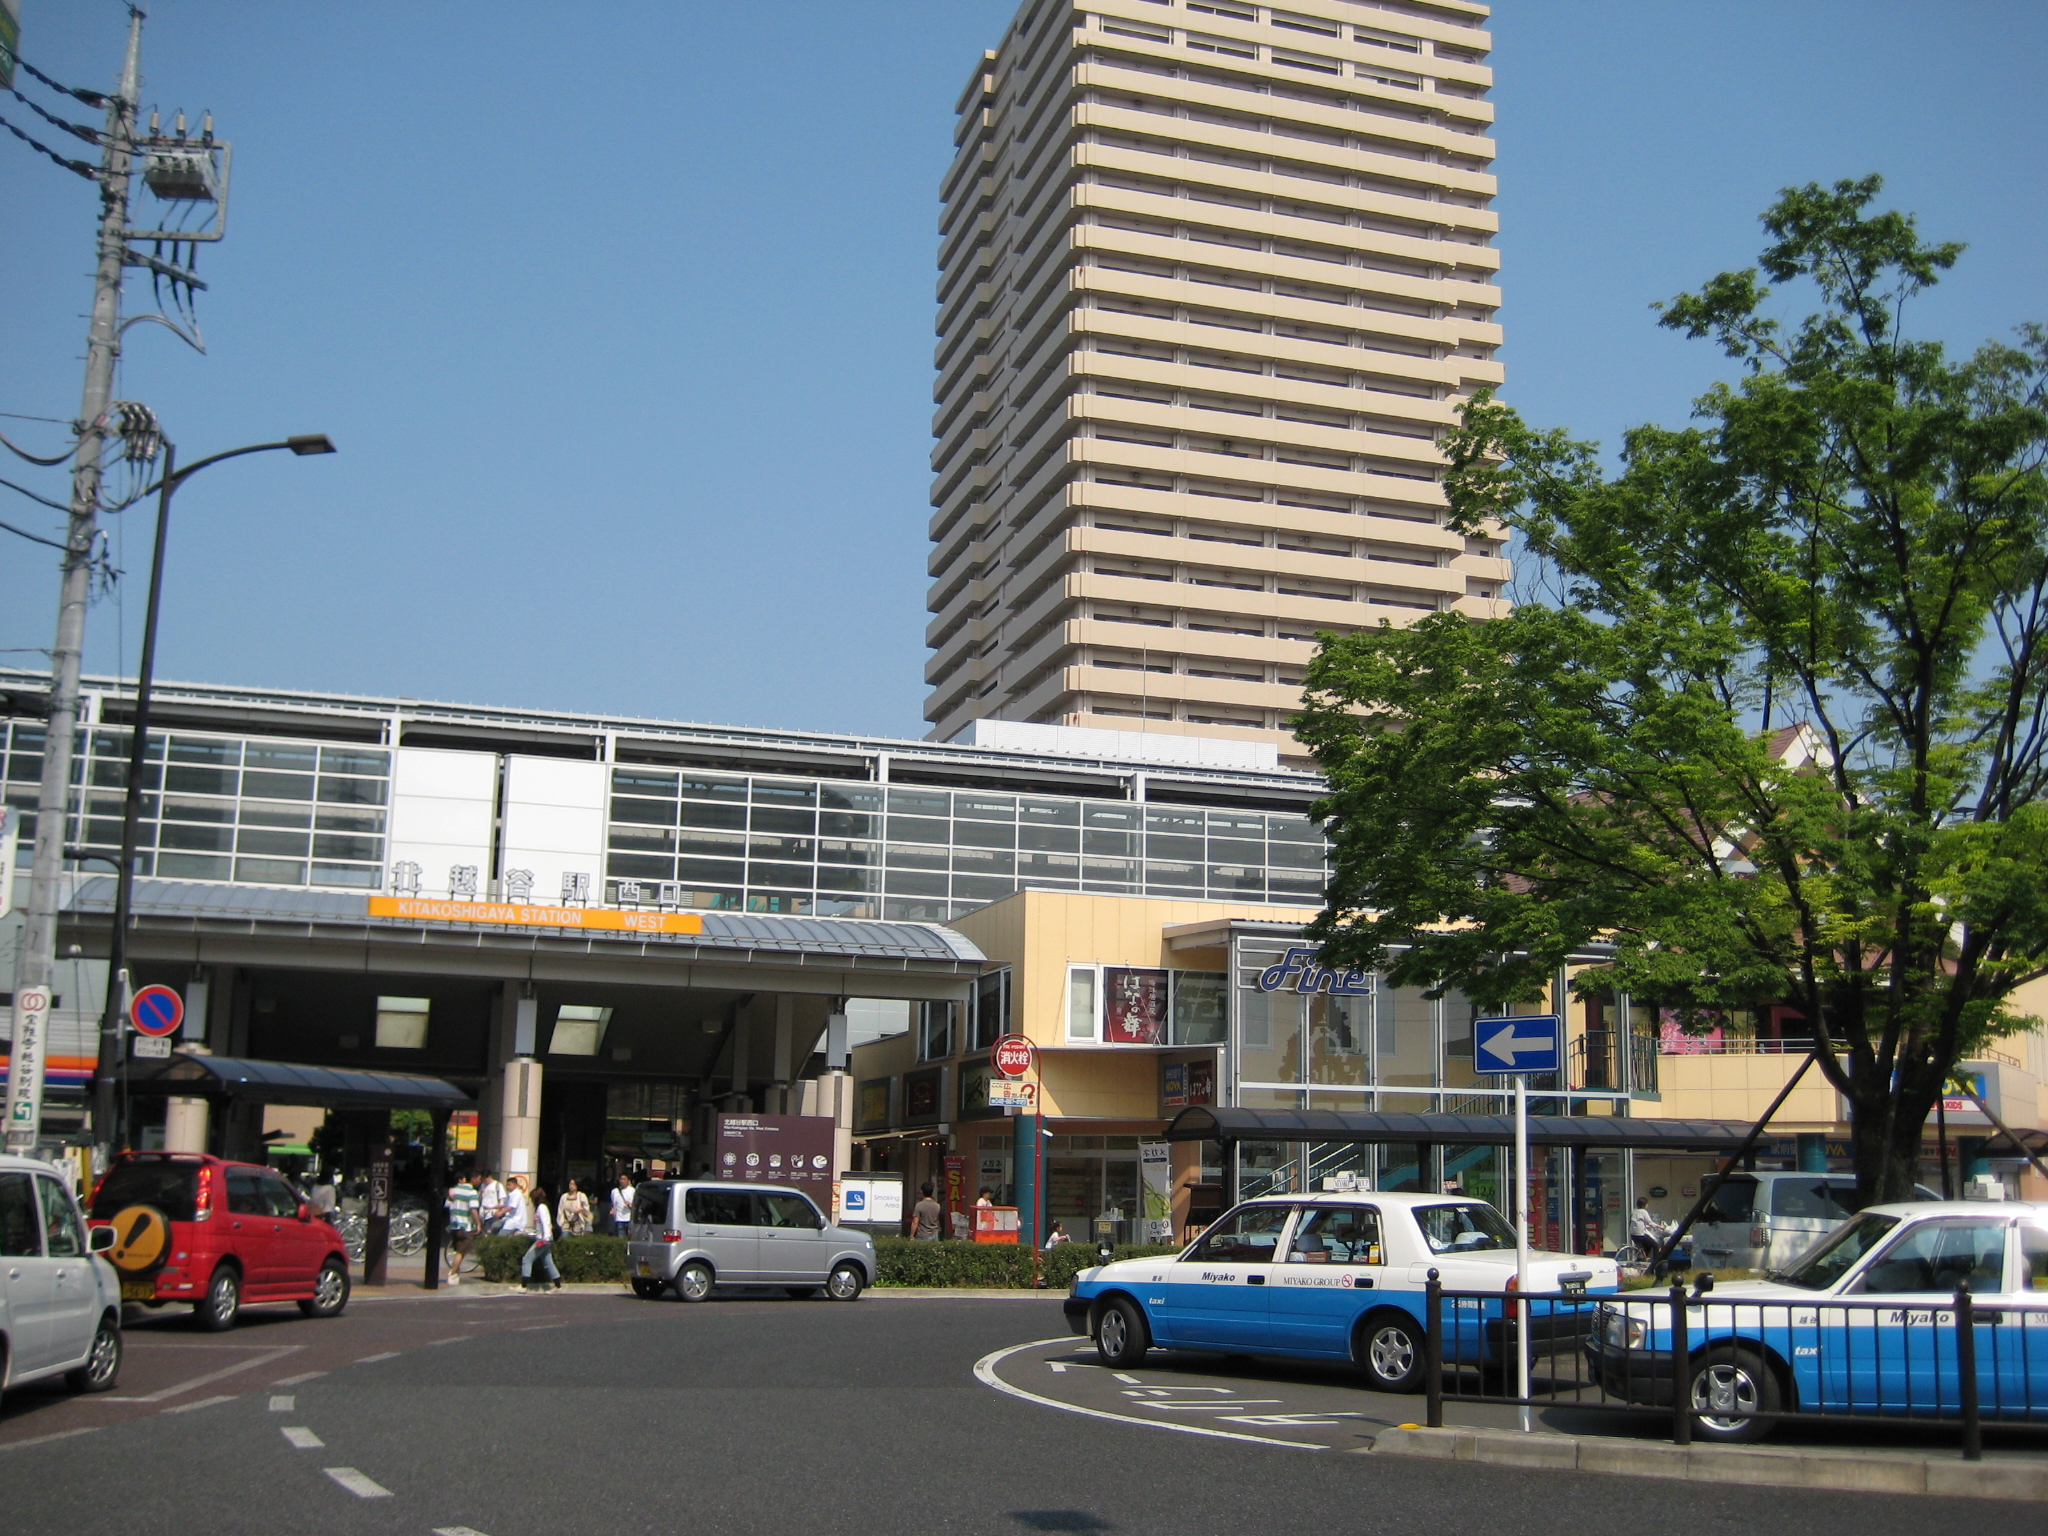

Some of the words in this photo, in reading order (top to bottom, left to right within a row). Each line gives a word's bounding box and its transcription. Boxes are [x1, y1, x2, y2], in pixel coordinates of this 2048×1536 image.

[397, 900, 516, 922] KITAKOSHIGAYA
[520, 909, 582, 925] STATION
[623, 914, 666, 929] WEST
[1258, 946, 1371, 995] Fine
[1000, 1051, 1029, 1065] 消火栓
[873, 1194, 900, 1202] Smoking
[1201, 1272, 1236, 1283] Miyako
[1283, 1277, 1312, 1285] MIYAKO
[1313, 1278, 1341, 1286] GROUP
[1148, 1297, 1166, 1305] taxi
[1794, 1345, 1823, 1356] tax
